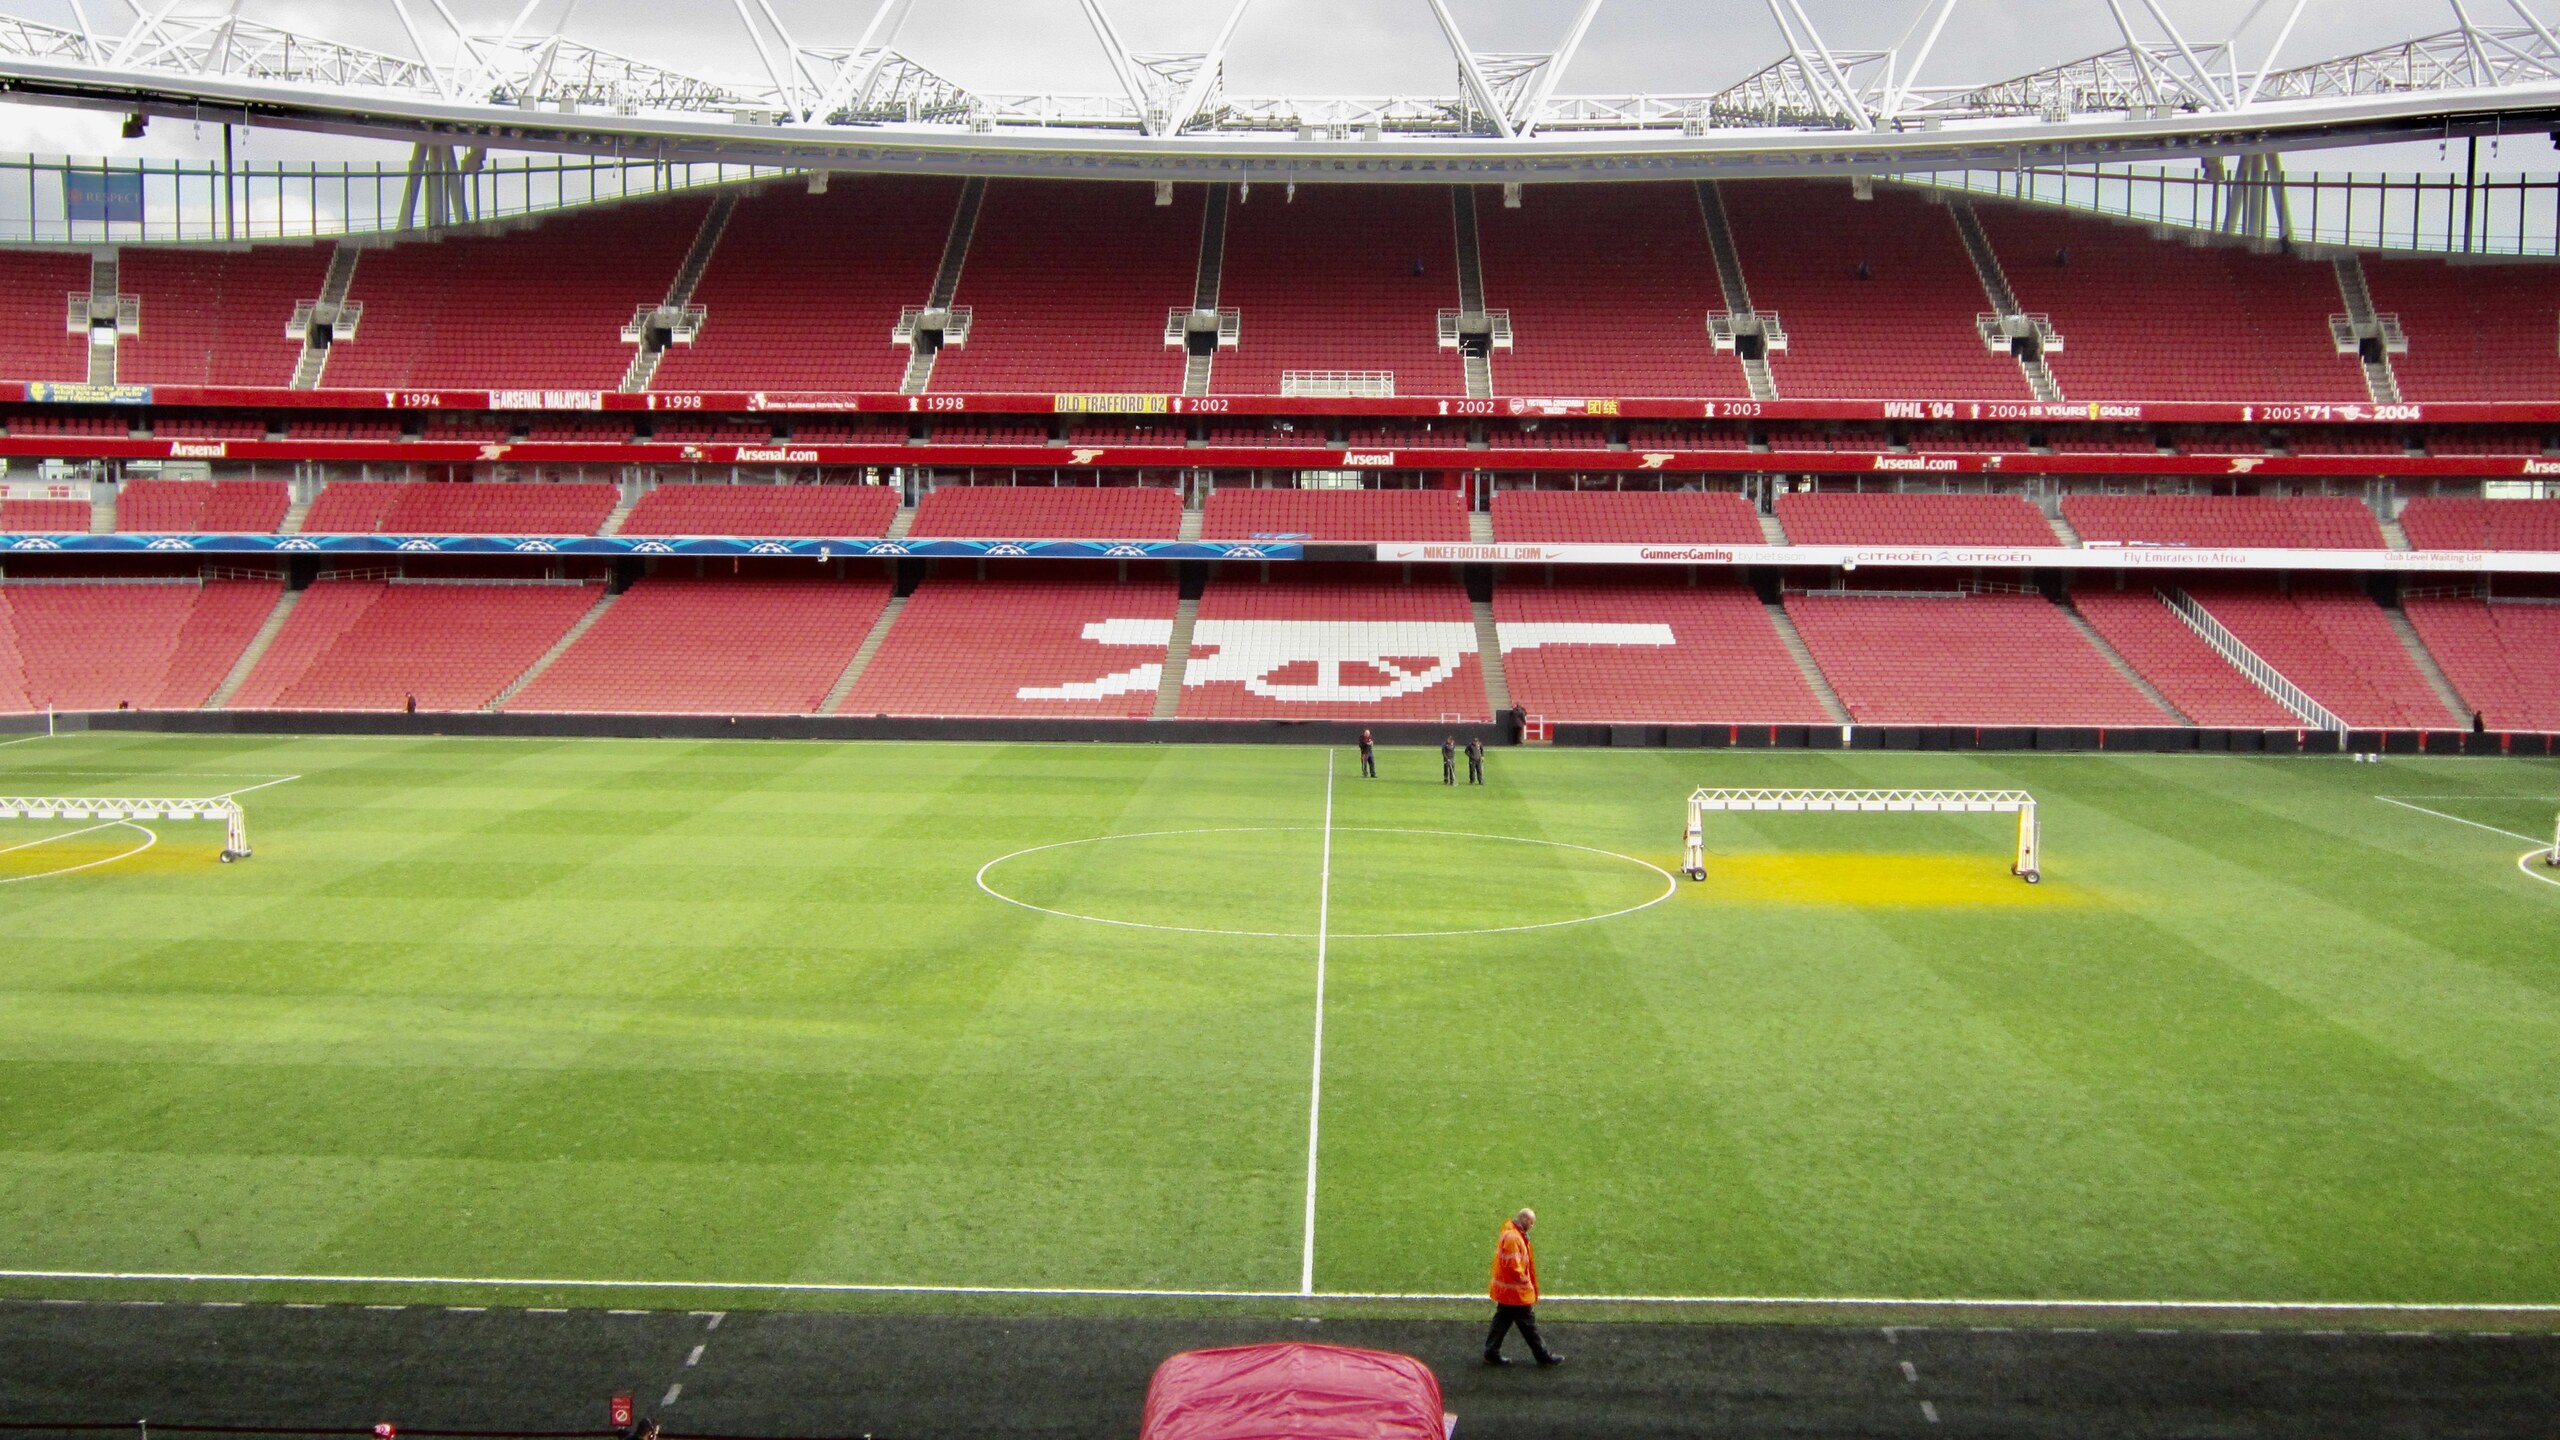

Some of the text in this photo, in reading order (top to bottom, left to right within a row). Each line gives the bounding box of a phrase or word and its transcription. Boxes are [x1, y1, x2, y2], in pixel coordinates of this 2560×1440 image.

[403, 393, 440, 407] 1994
[501, 391, 590, 408] ARSENAL MALAYSIA
[665, 395, 701, 408] 1998
[927, 397, 964, 410] 1998
[1057, 395, 1079, 412] OLD
[1084, 396, 1144, 412] TRAFFORD
[1191, 399, 1229, 412] 2002
[1457, 401, 1495, 413] 2002
[1587, 399, 1618, 415] 团结
[1723, 402, 1761, 416] 2003
[1884, 402, 1924, 418] WHL
[1989, 405, 2027, 418] 2004
[2030, 405, 2141, 417] IS YOURS GOLD?
[2263, 407, 2301, 420] 2005
[2374, 405, 2420, 420] 2004
[170, 441, 225, 457] Arsenal
[735, 446, 818, 462] Arsenal.com
[1343, 451, 1394, 466] Arsenal
[1874, 455, 1957, 470] Arsenal.com
[2523, 459, 2560, 474] Arse
[1423, 546, 1541, 559] NIKEFOOTBALL.COM
[1640, 548, 1806, 562] GunnersGaming by betsson
[2124, 552, 2246, 564] Fly Emirates to Africa
[2384, 552, 2482, 563] Club Level Waiting List
